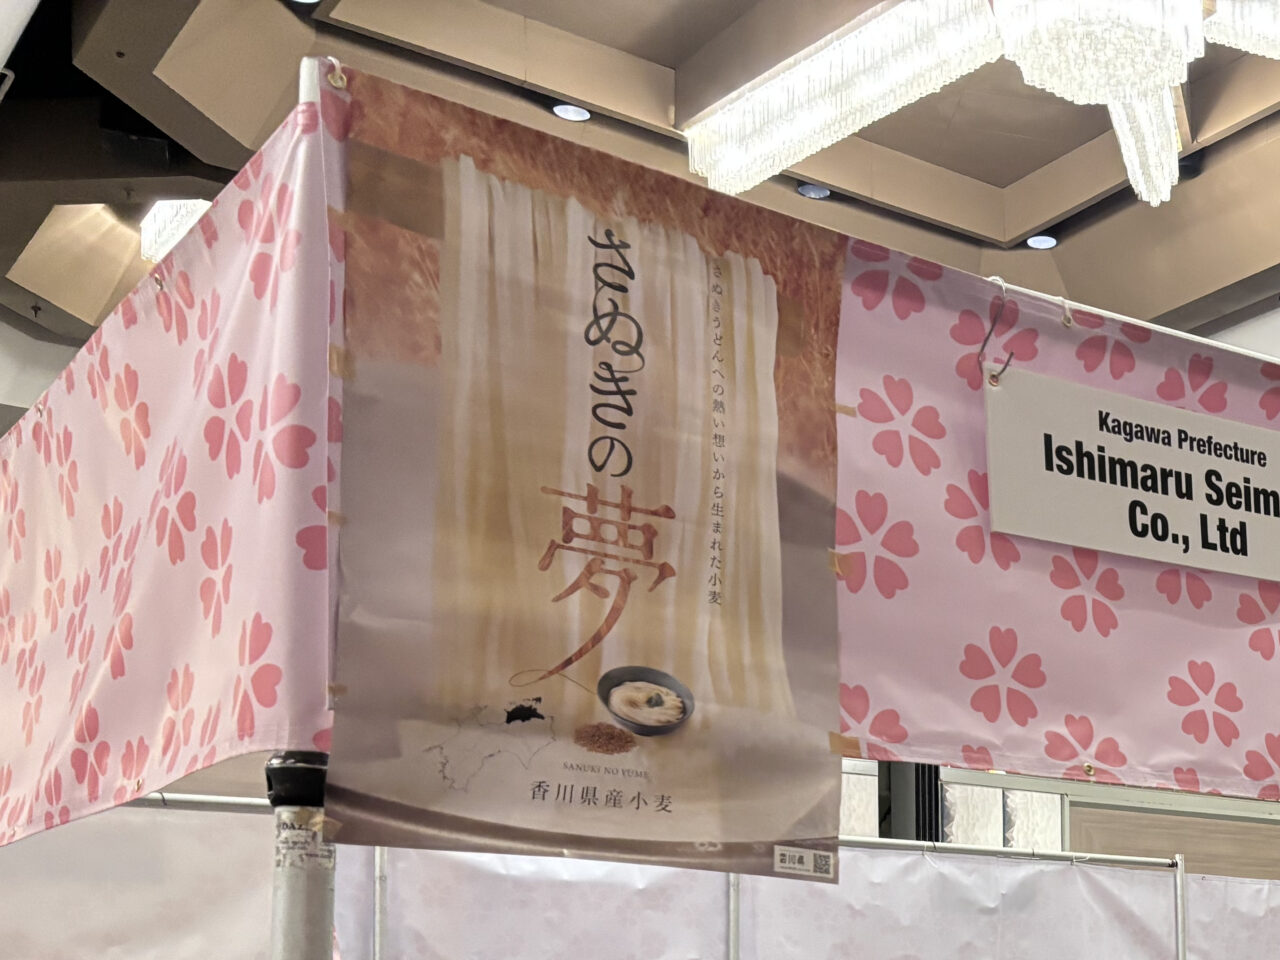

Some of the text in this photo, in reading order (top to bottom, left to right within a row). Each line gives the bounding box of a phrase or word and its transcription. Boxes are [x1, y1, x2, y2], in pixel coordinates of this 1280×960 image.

[1043, 432, 1194, 501] Ishimaru
[1098, 409, 1267, 467] Kagawa Prefecture
[1128, 500, 1248, 557] Co., Ltd
[530, 781, 672, 814] 香川県産小麦
